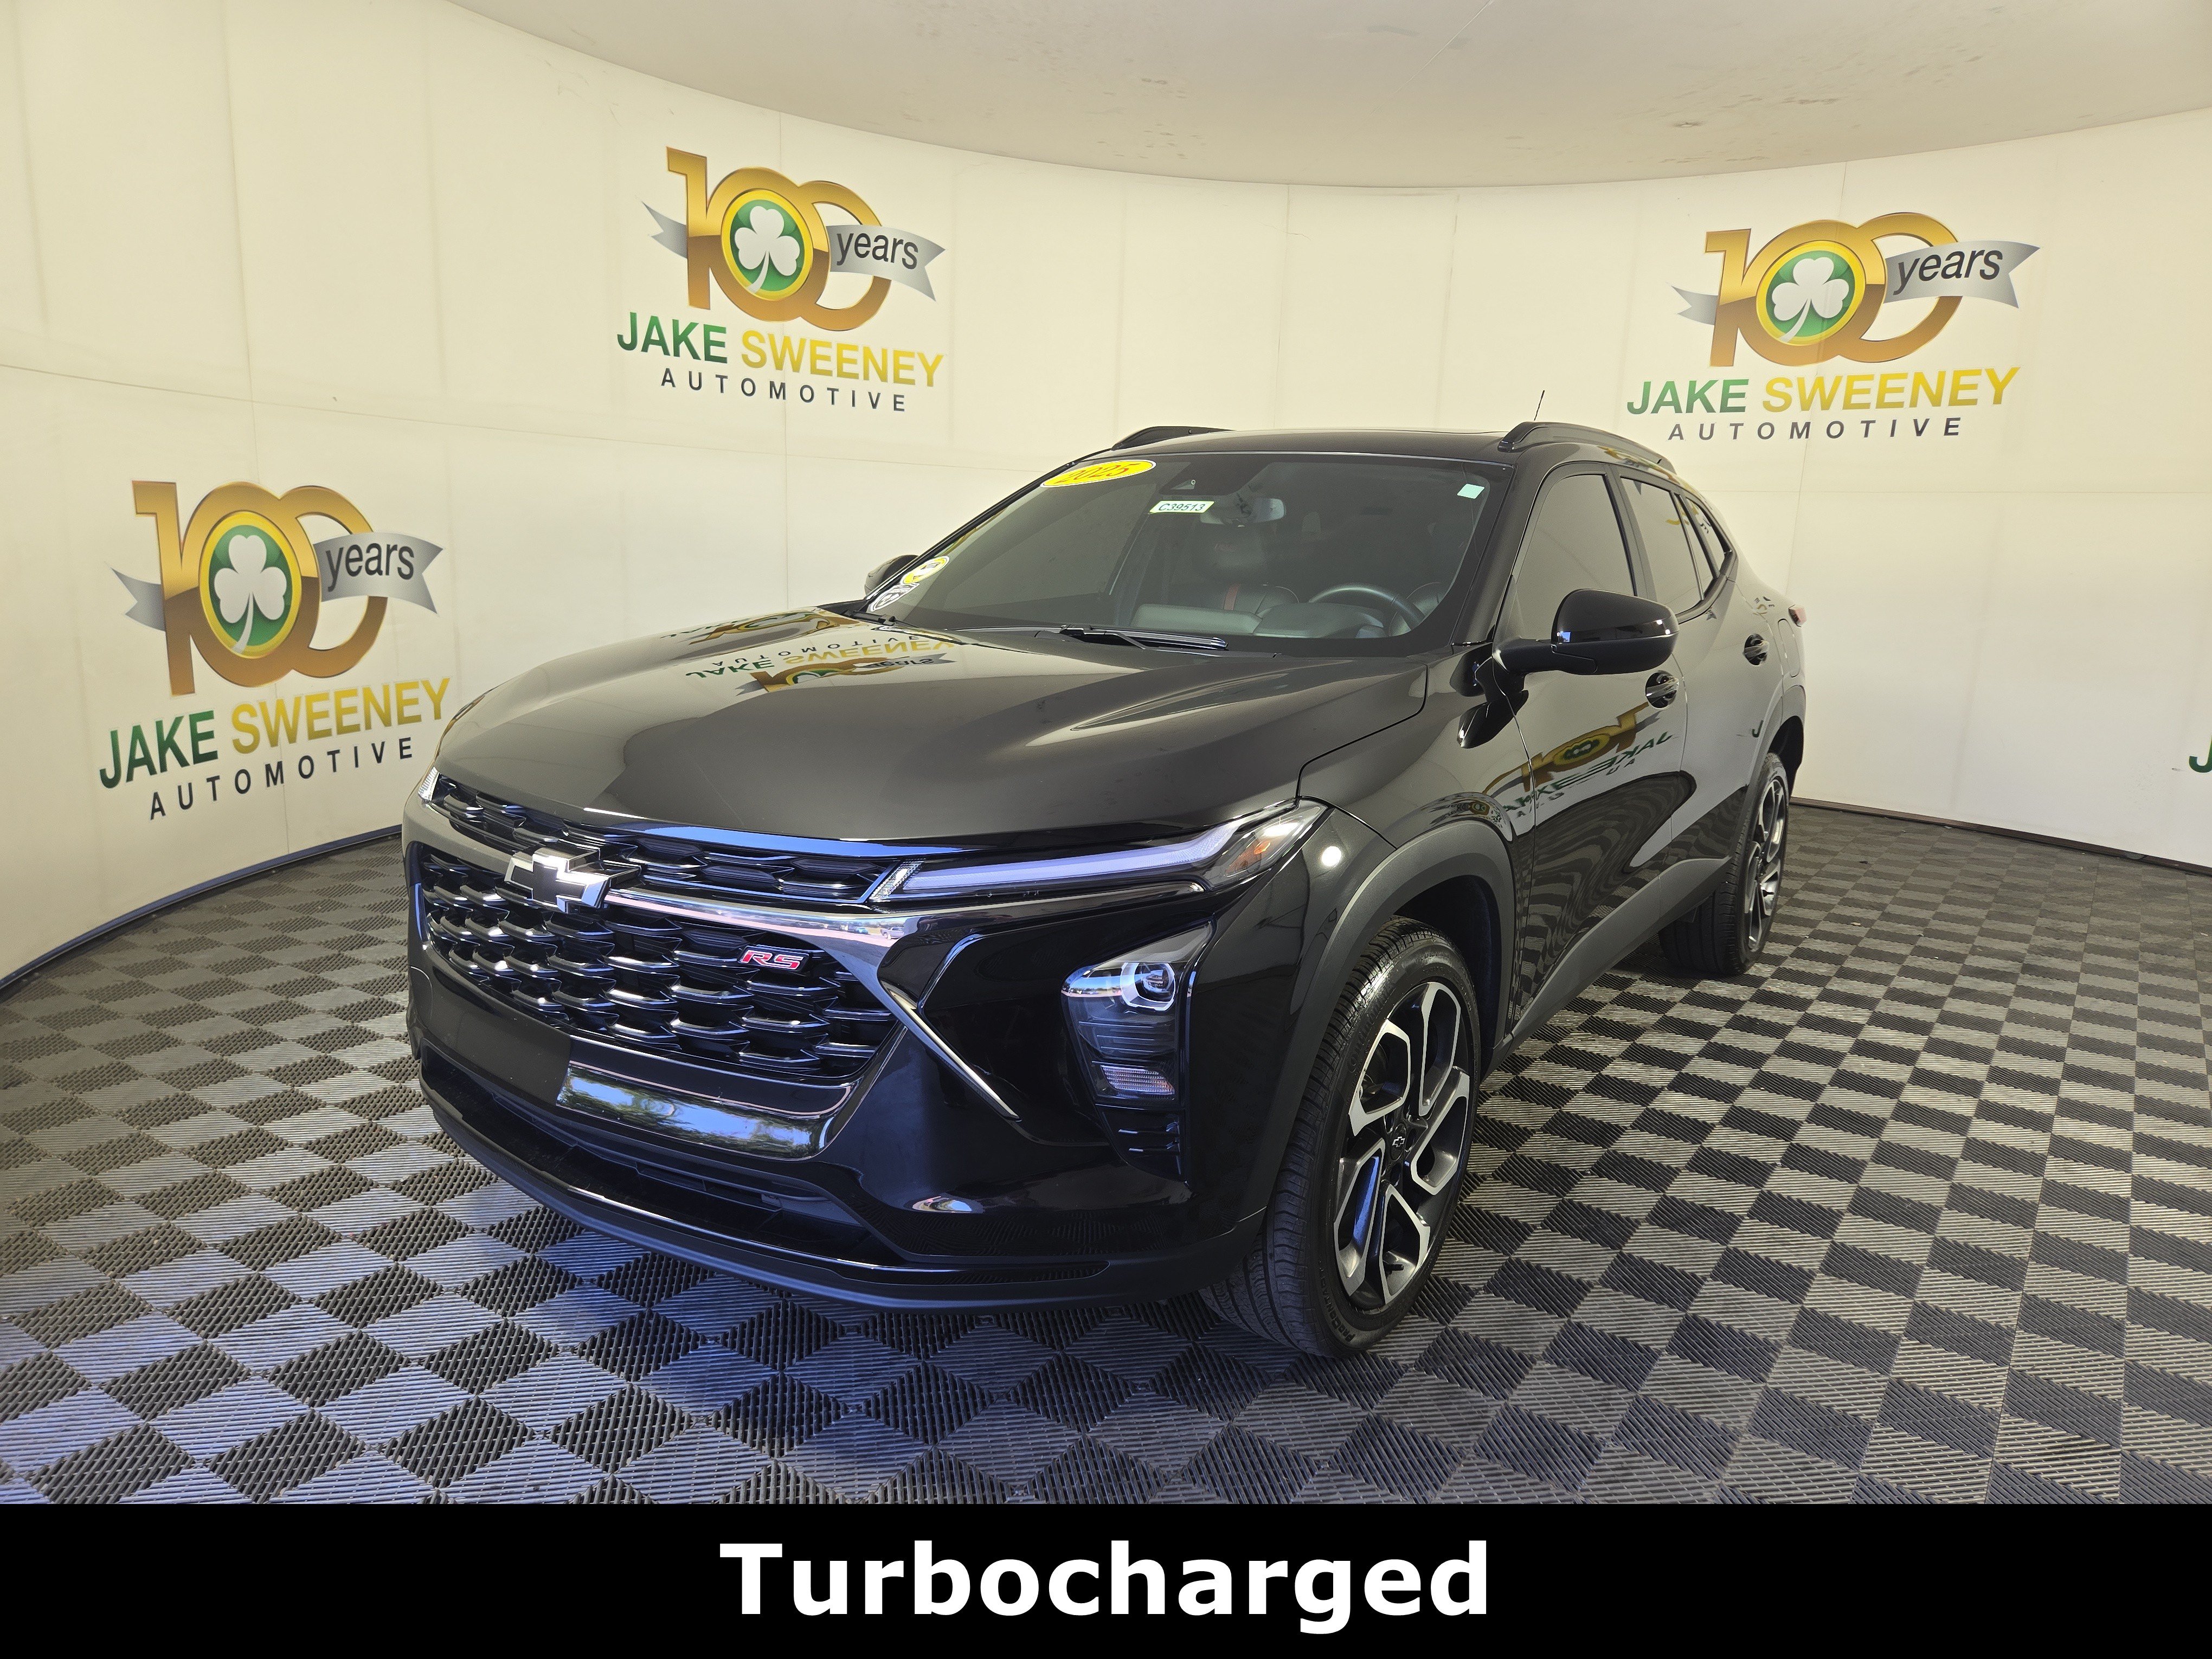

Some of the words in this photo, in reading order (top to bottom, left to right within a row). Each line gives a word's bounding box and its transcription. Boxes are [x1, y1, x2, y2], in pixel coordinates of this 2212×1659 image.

[666, 146, 892, 332] 100
[835, 232, 919, 270] years
[1704, 211, 1962, 368] 100
[1892, 248, 2003, 296] years
[616, 311, 728, 364] JAKE
[741, 330, 944, 388] SWEENEY
[660, 367, 905, 412] AUTOMOTIVE
[1626, 378, 1750, 415] JAKE
[1762, 366, 2021, 413] SWEENEY
[1668, 417, 1962, 441] AUTOMOTIVE
[1056, 462, 1141, 484] 2025
[1158, 503, 1206, 512] C39513
[132, 480, 388, 697] 100
[325, 542, 415, 593] years
[99, 710, 218, 789] JAKE
[230, 678, 451, 755] SWEENEY
[150, 737, 412, 820] AUTOMOTIVE
[741, 949, 804, 970] RS
